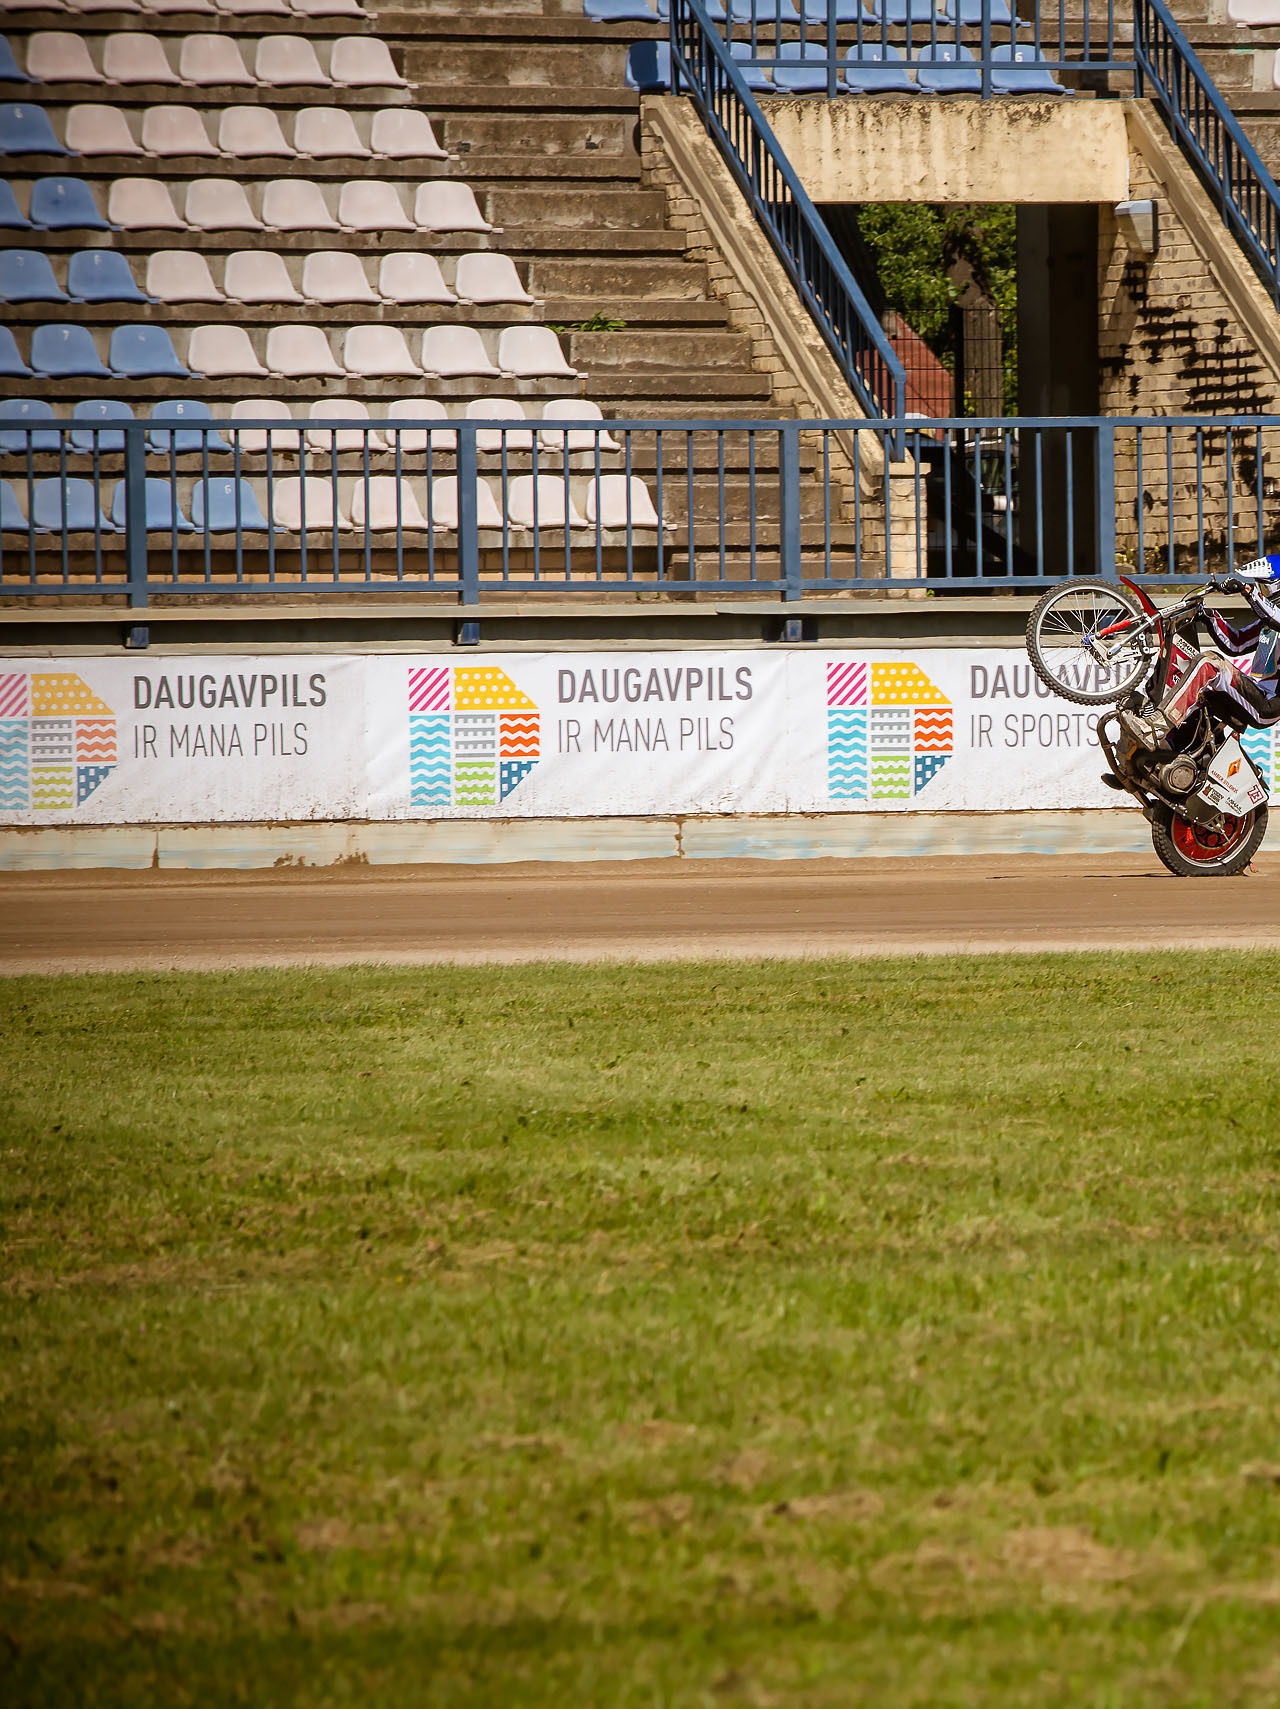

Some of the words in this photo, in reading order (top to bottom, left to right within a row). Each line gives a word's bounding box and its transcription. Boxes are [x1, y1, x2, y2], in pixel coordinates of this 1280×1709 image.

[1014, 51, 1024, 62] 6
[134, 673, 327, 709] DAUGAVPILS
[558, 666, 753, 703] DAUGAVPILS
[134, 724, 158, 759] IR
[170, 723, 244, 758] MANA
[254, 721, 308, 757] PILS
[558, 719, 582, 753] IR
[594, 717, 670, 752] MANA
[680, 716, 735, 751] PILS
[970, 714, 993, 748] IR
[1004, 713, 1099, 748] SPORTS
